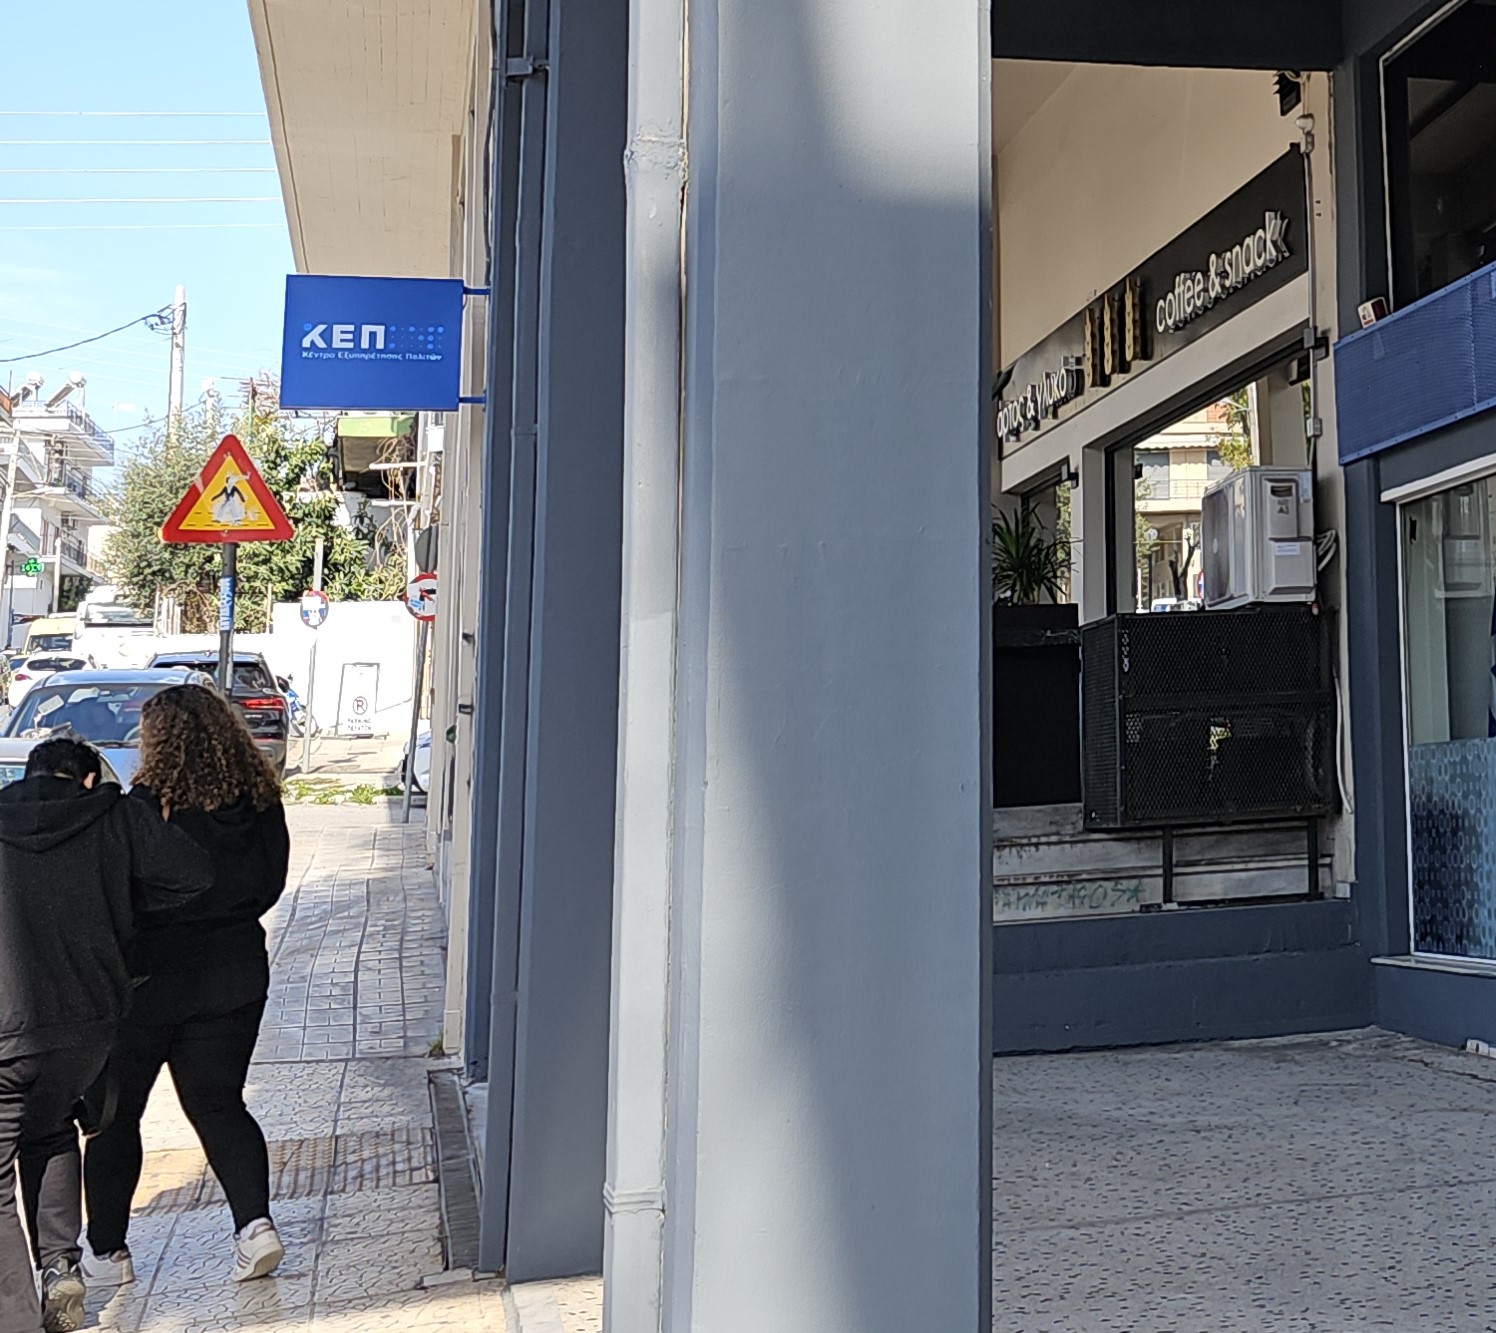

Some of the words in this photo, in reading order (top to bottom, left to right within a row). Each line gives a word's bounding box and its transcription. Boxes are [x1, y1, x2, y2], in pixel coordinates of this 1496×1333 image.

[1156, 271, 1204, 332] coffee
[1208, 253, 1222, 298] &
[1224, 211, 1283, 288] snack
[301, 324, 386, 350] ΚΕΠ
[301, 350, 336, 360] Κέντρο
[337, 350, 403, 361] Εξυπηρέτησης
[405, 352, 443, 361] Πολιτών
[997, 400, 1024, 442] άρτος
